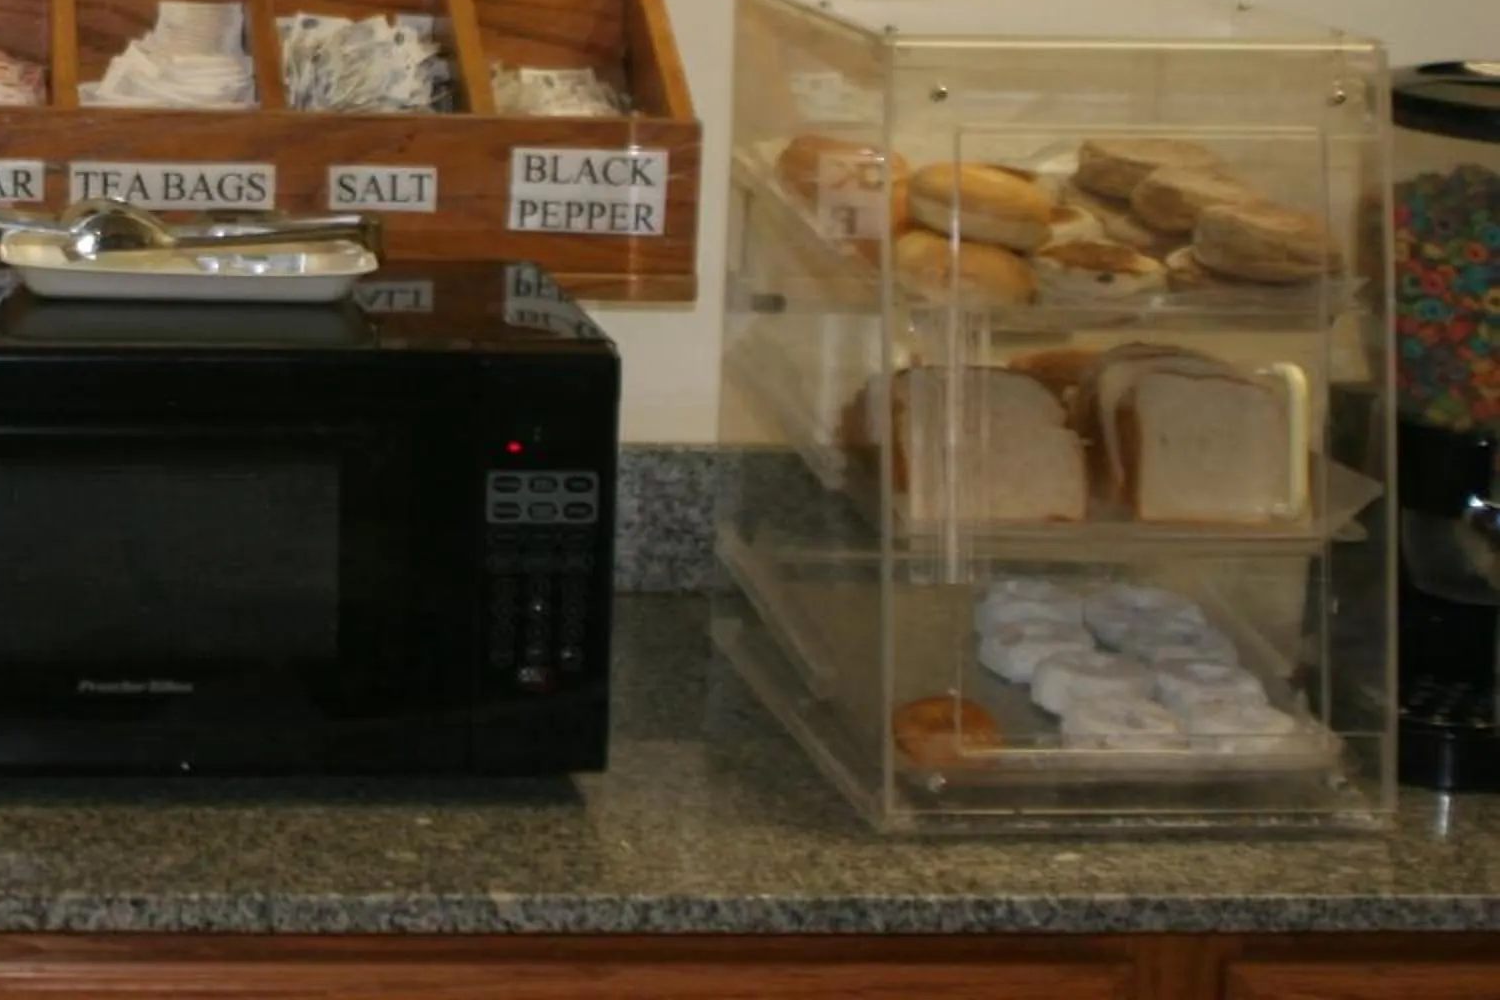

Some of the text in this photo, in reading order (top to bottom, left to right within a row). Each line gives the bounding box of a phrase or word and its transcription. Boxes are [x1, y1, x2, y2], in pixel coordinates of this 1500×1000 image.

[523, 152, 657, 187] BLACK
[75, 170, 267, 203] TEA BAGS
[336, 172, 434, 205] SALT
[518, 199, 657, 232] PEPPER
